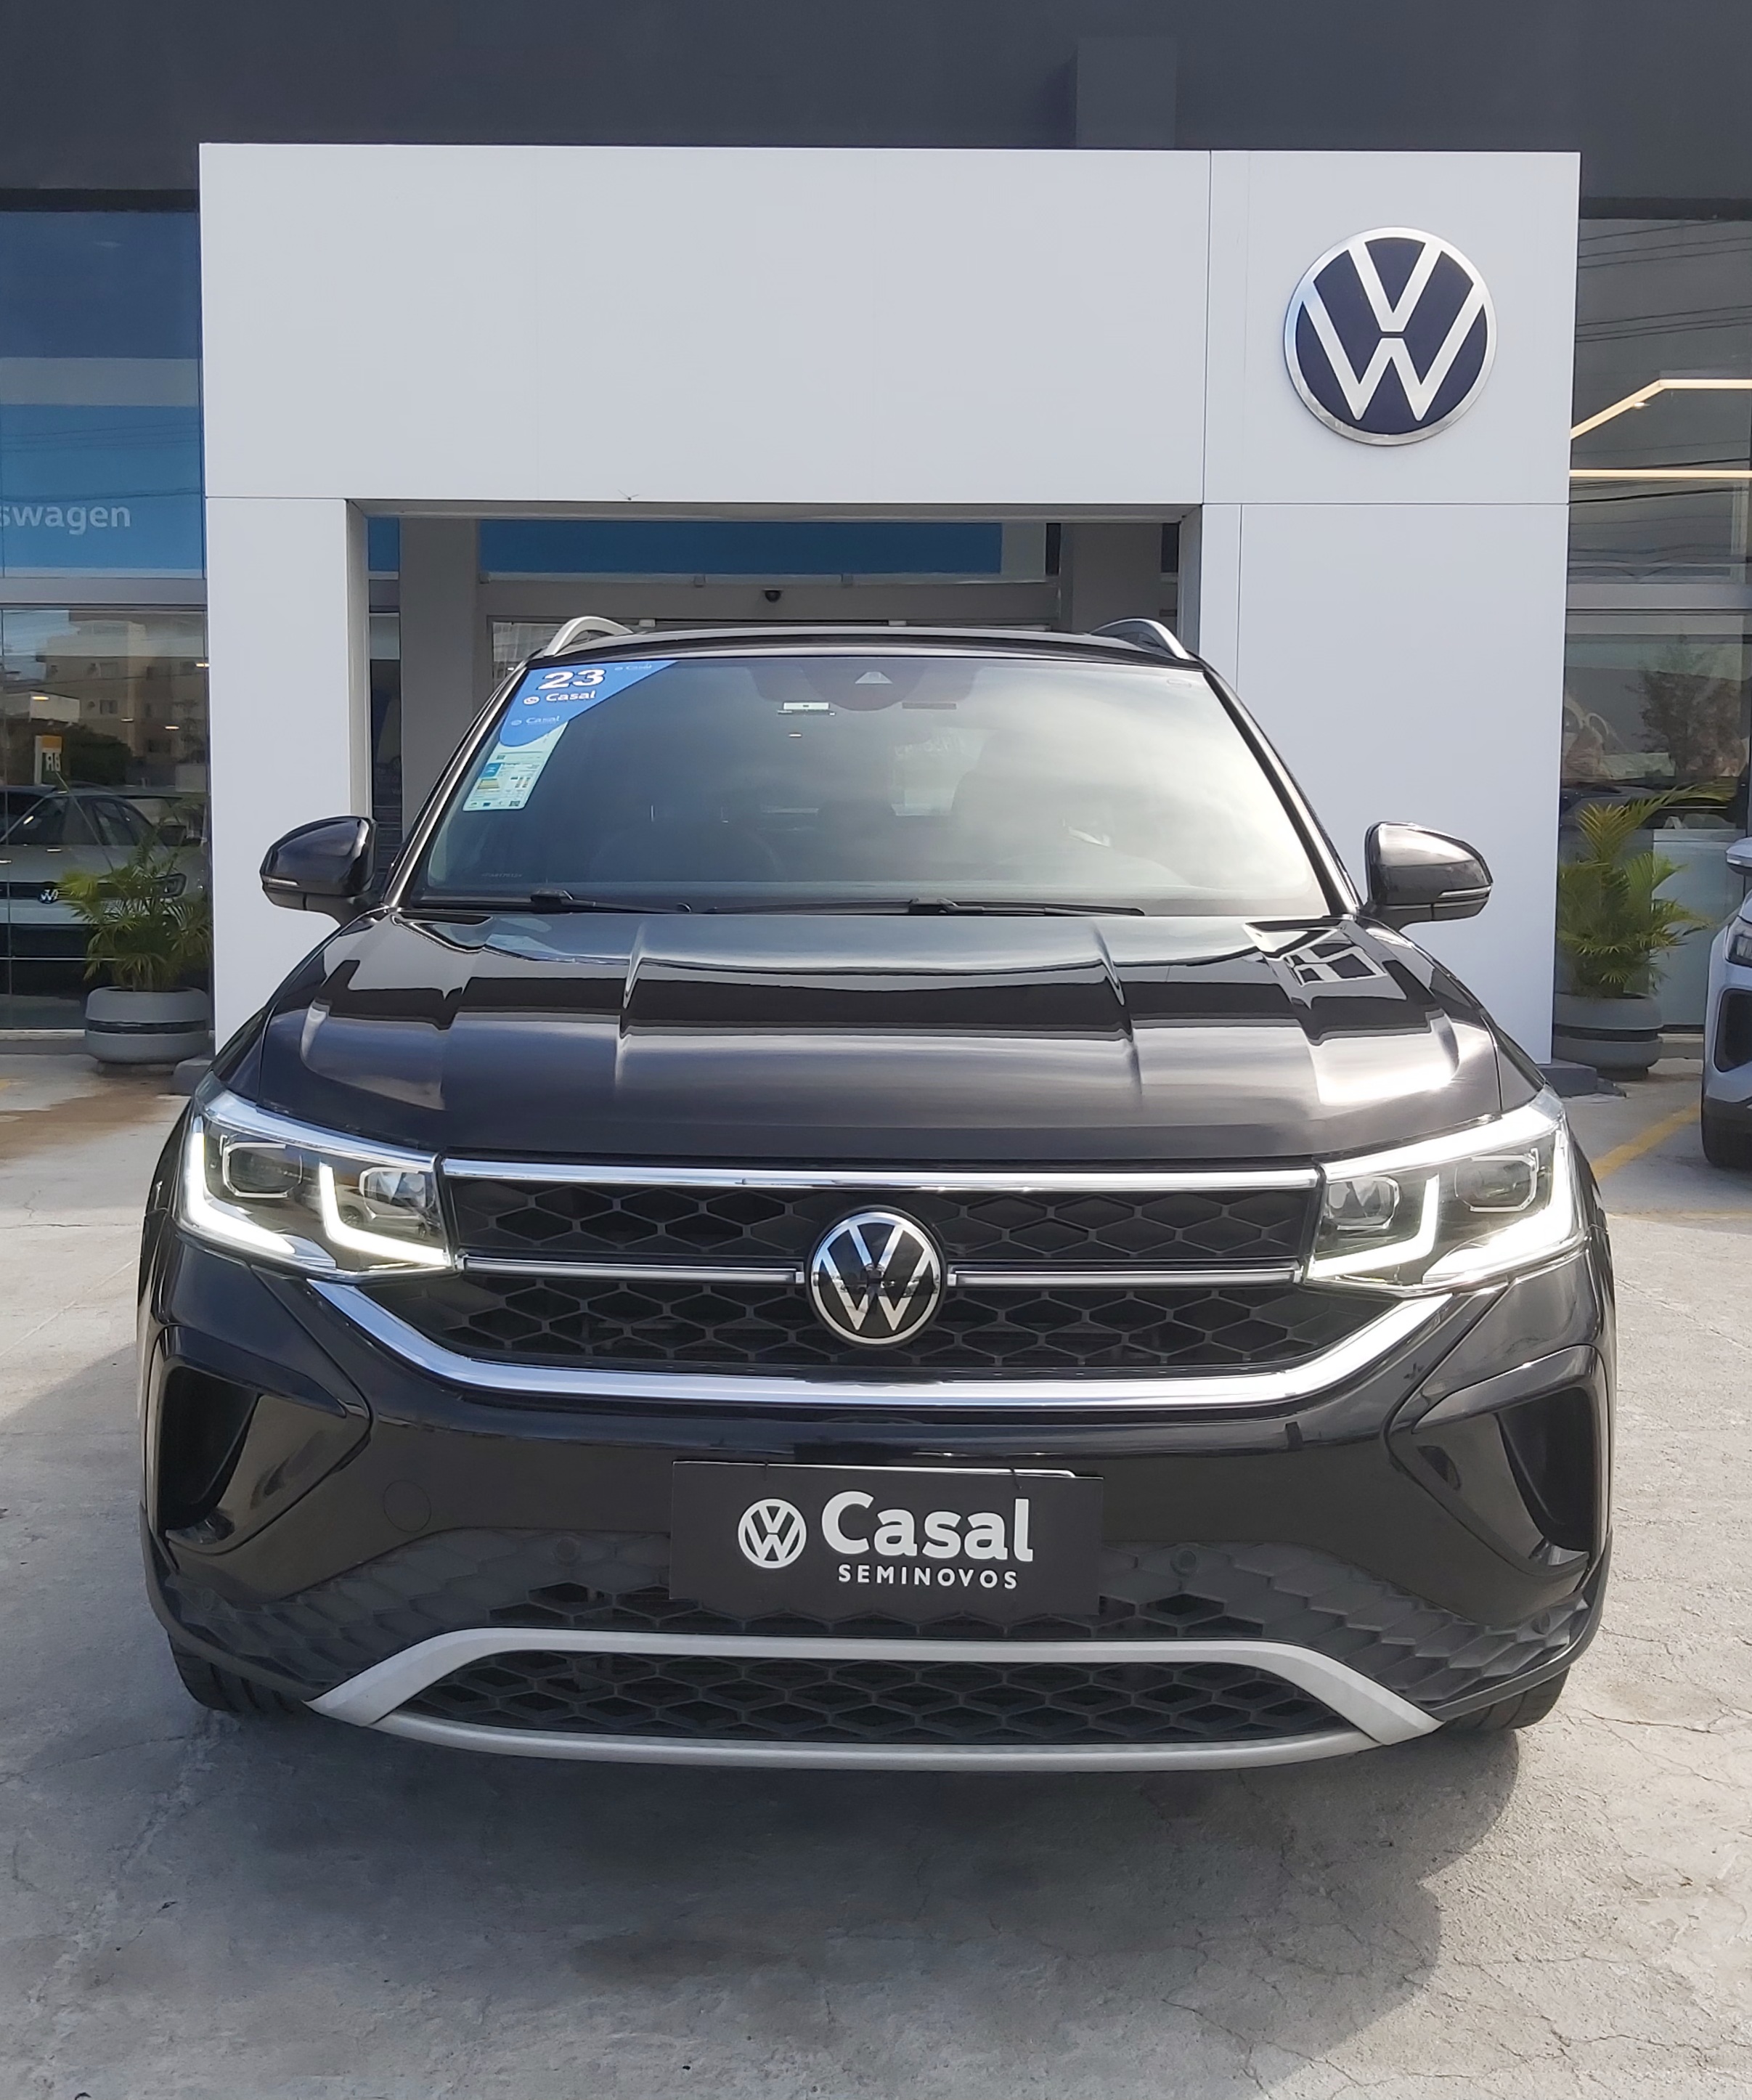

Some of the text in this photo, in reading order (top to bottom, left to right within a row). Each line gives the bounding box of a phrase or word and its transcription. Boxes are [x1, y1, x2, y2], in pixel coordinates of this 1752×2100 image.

[538, 669, 605, 691] 23
[545, 691, 596, 701] Casal
[526, 715, 561, 724] Casal
[821, 1490, 1034, 1562] Casal
[838, 1563, 1018, 1590] SEMINOVOS
